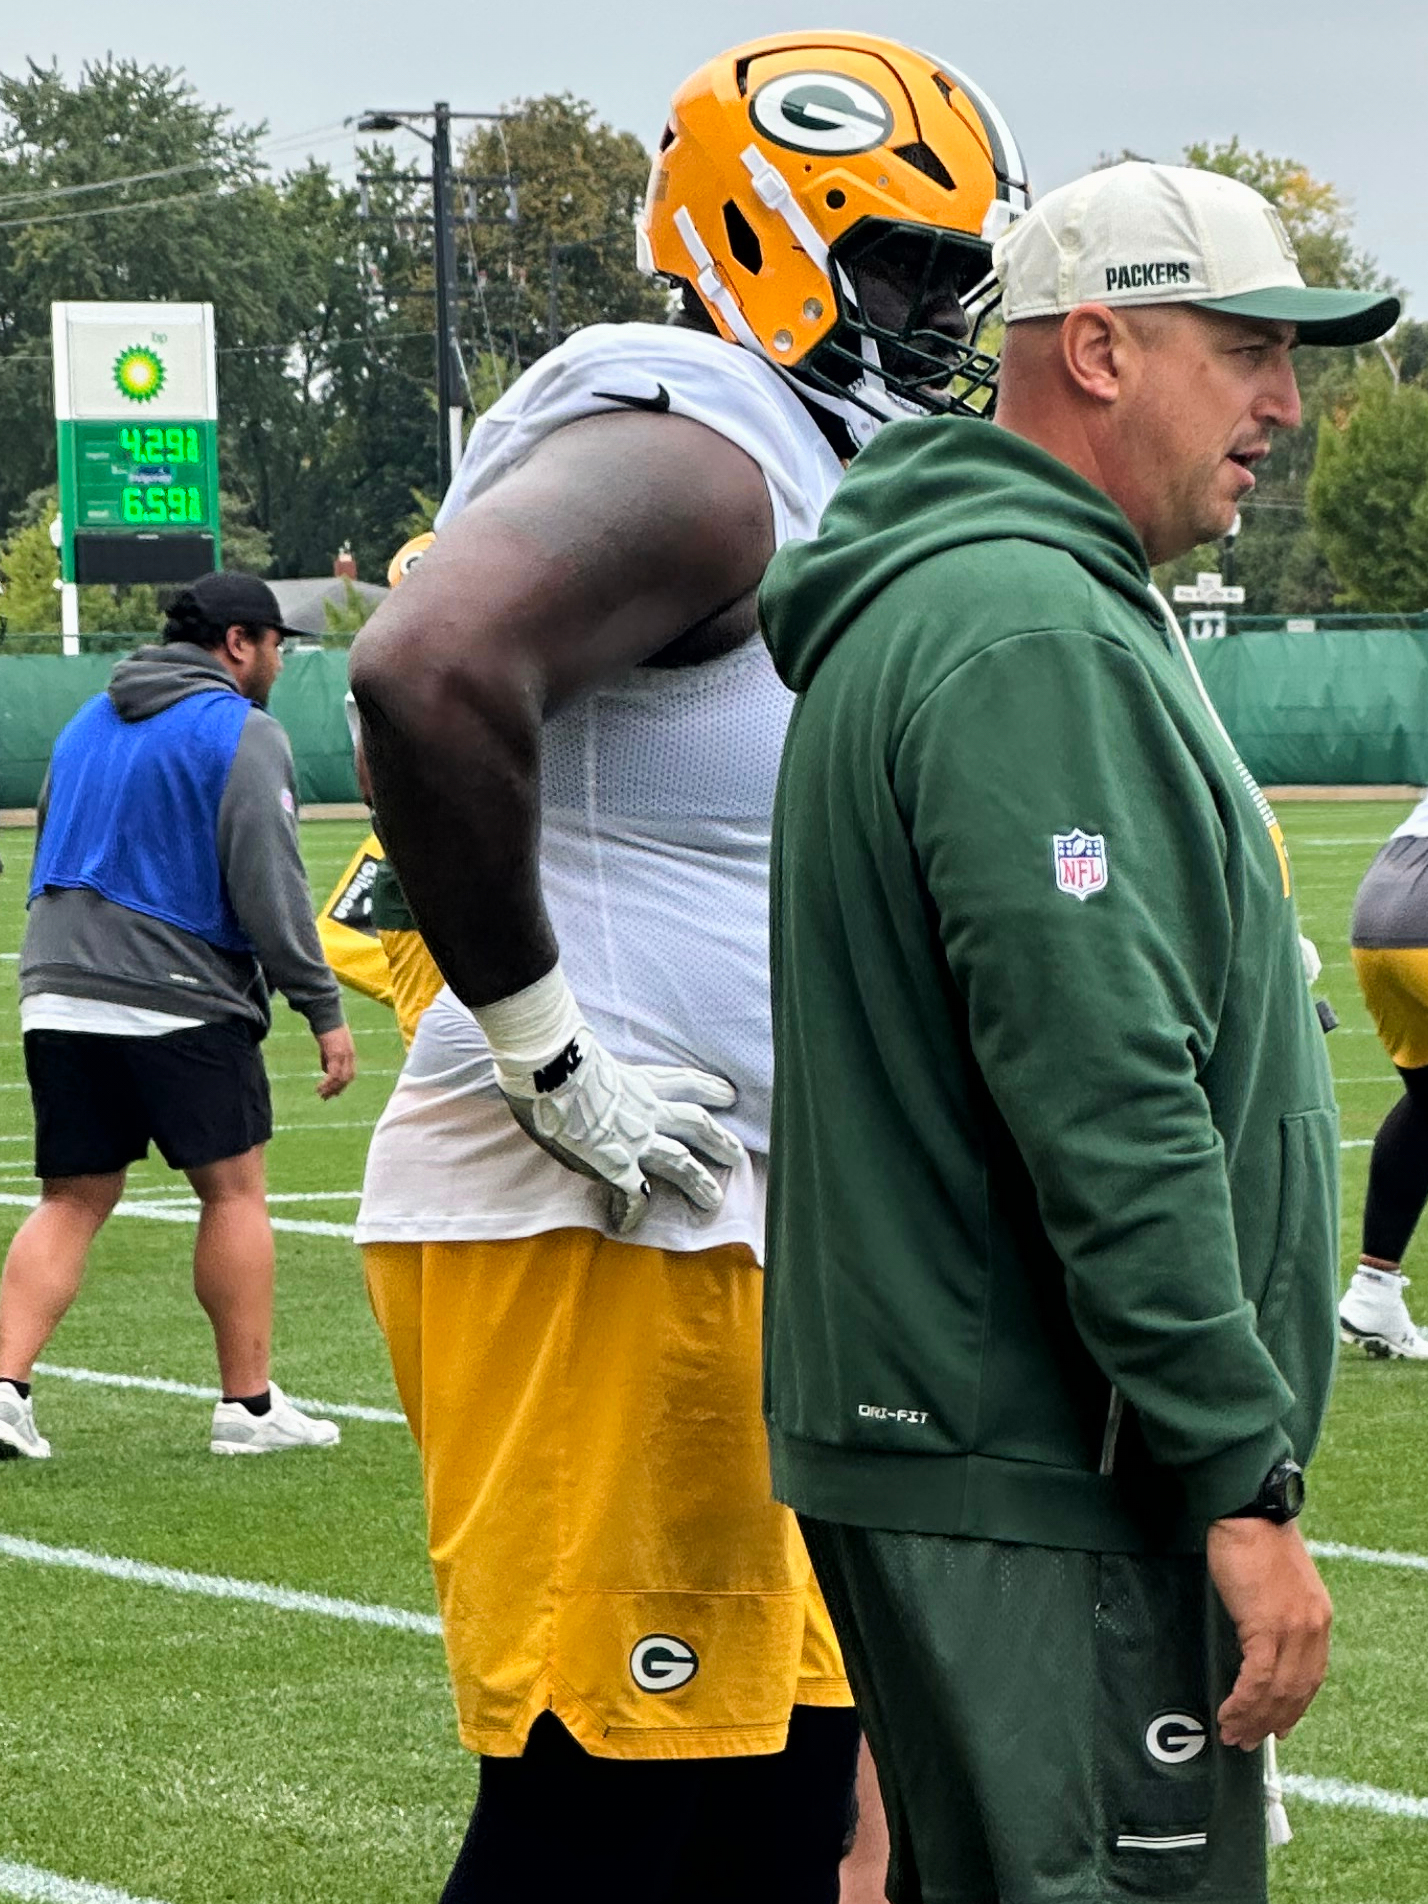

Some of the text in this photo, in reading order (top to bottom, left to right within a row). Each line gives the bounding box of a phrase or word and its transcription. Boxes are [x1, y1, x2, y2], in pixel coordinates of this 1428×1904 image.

[755, 73, 886, 151] G
[1105, 262, 1190, 291] PACKERS
[152, 331, 168, 345] bp
[1062, 859, 1100, 888] NFL
[858, 1404, 929, 1424] DRI-FIT
[631, 1637, 695, 1690] G
[1146, 1714, 1206, 1764] G
